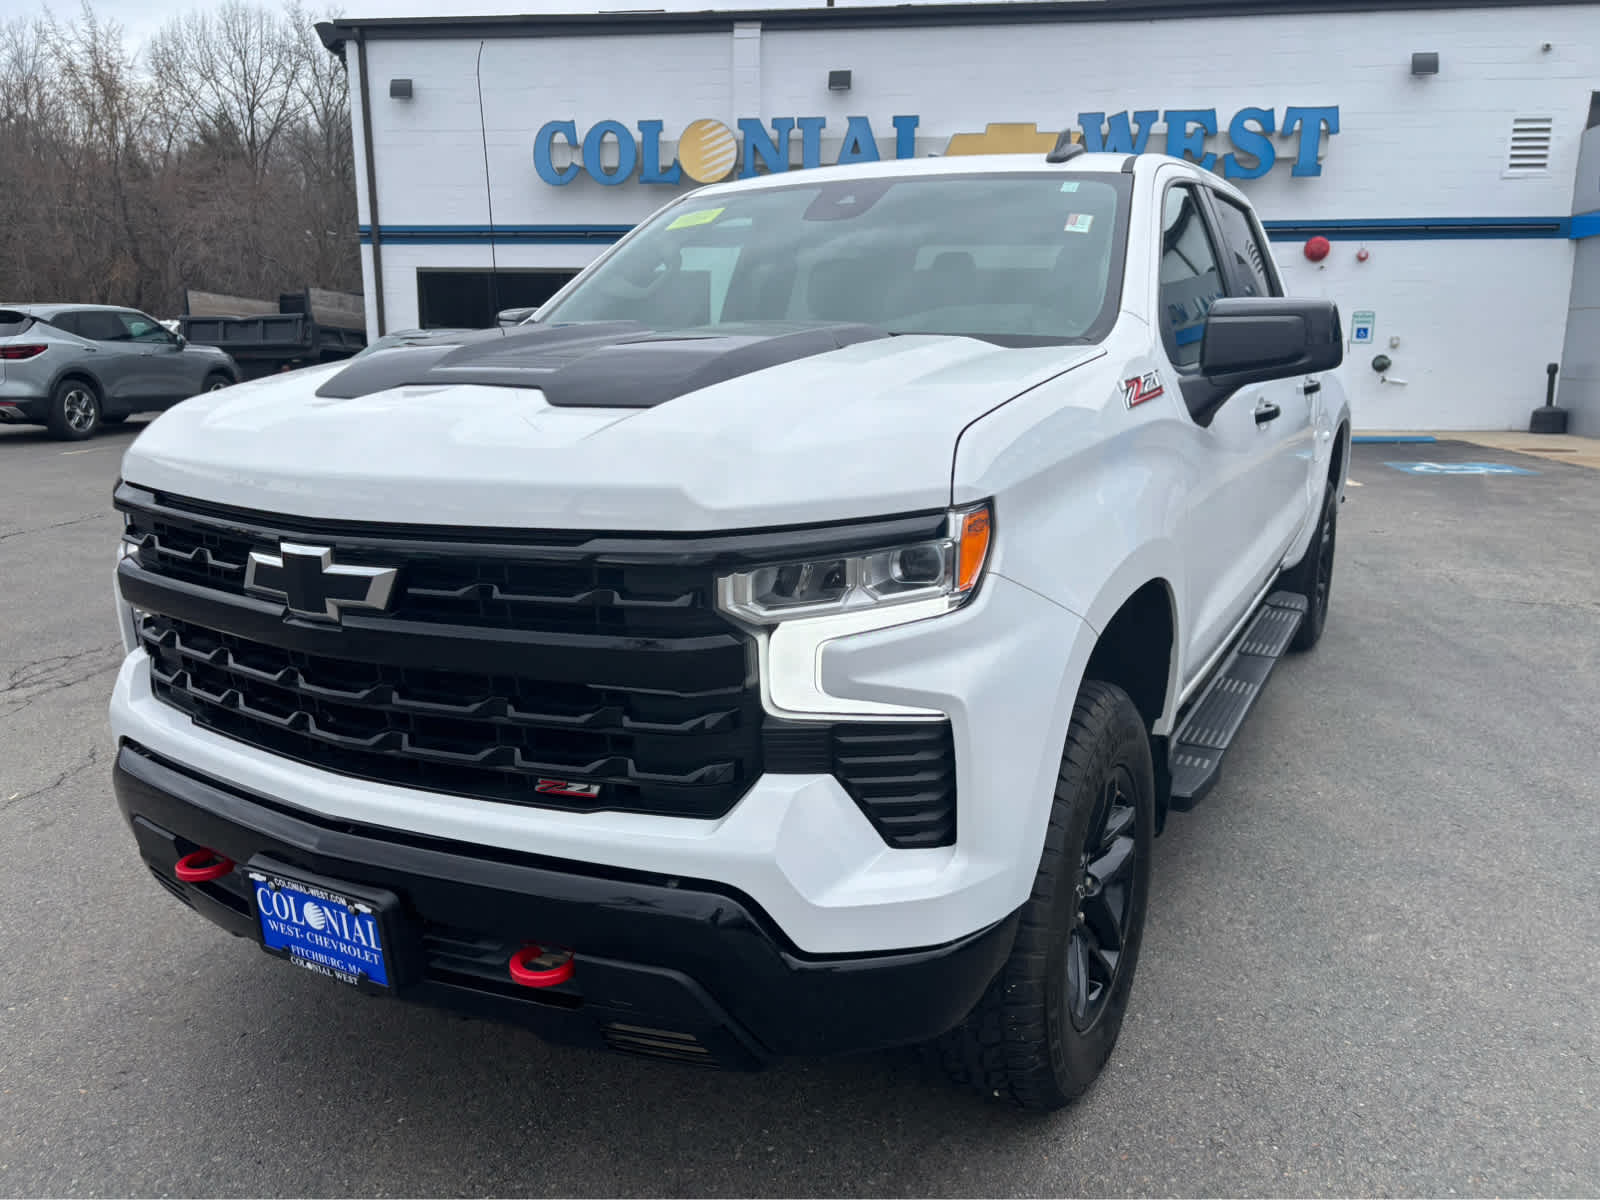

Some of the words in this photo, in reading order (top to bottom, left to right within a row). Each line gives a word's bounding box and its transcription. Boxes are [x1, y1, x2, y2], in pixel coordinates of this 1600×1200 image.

[533, 115, 920, 187] COLONIAL
[1077, 105, 1340, 180] WEST
[256, 887, 382, 951] COLONIAL
[291, 944, 347, 971] FITCHBURG,
[306, 931, 380, 965] CHEVROLET
[290, 955, 334, 977] COLONIAL
[334, 970, 359, 985] WEST
